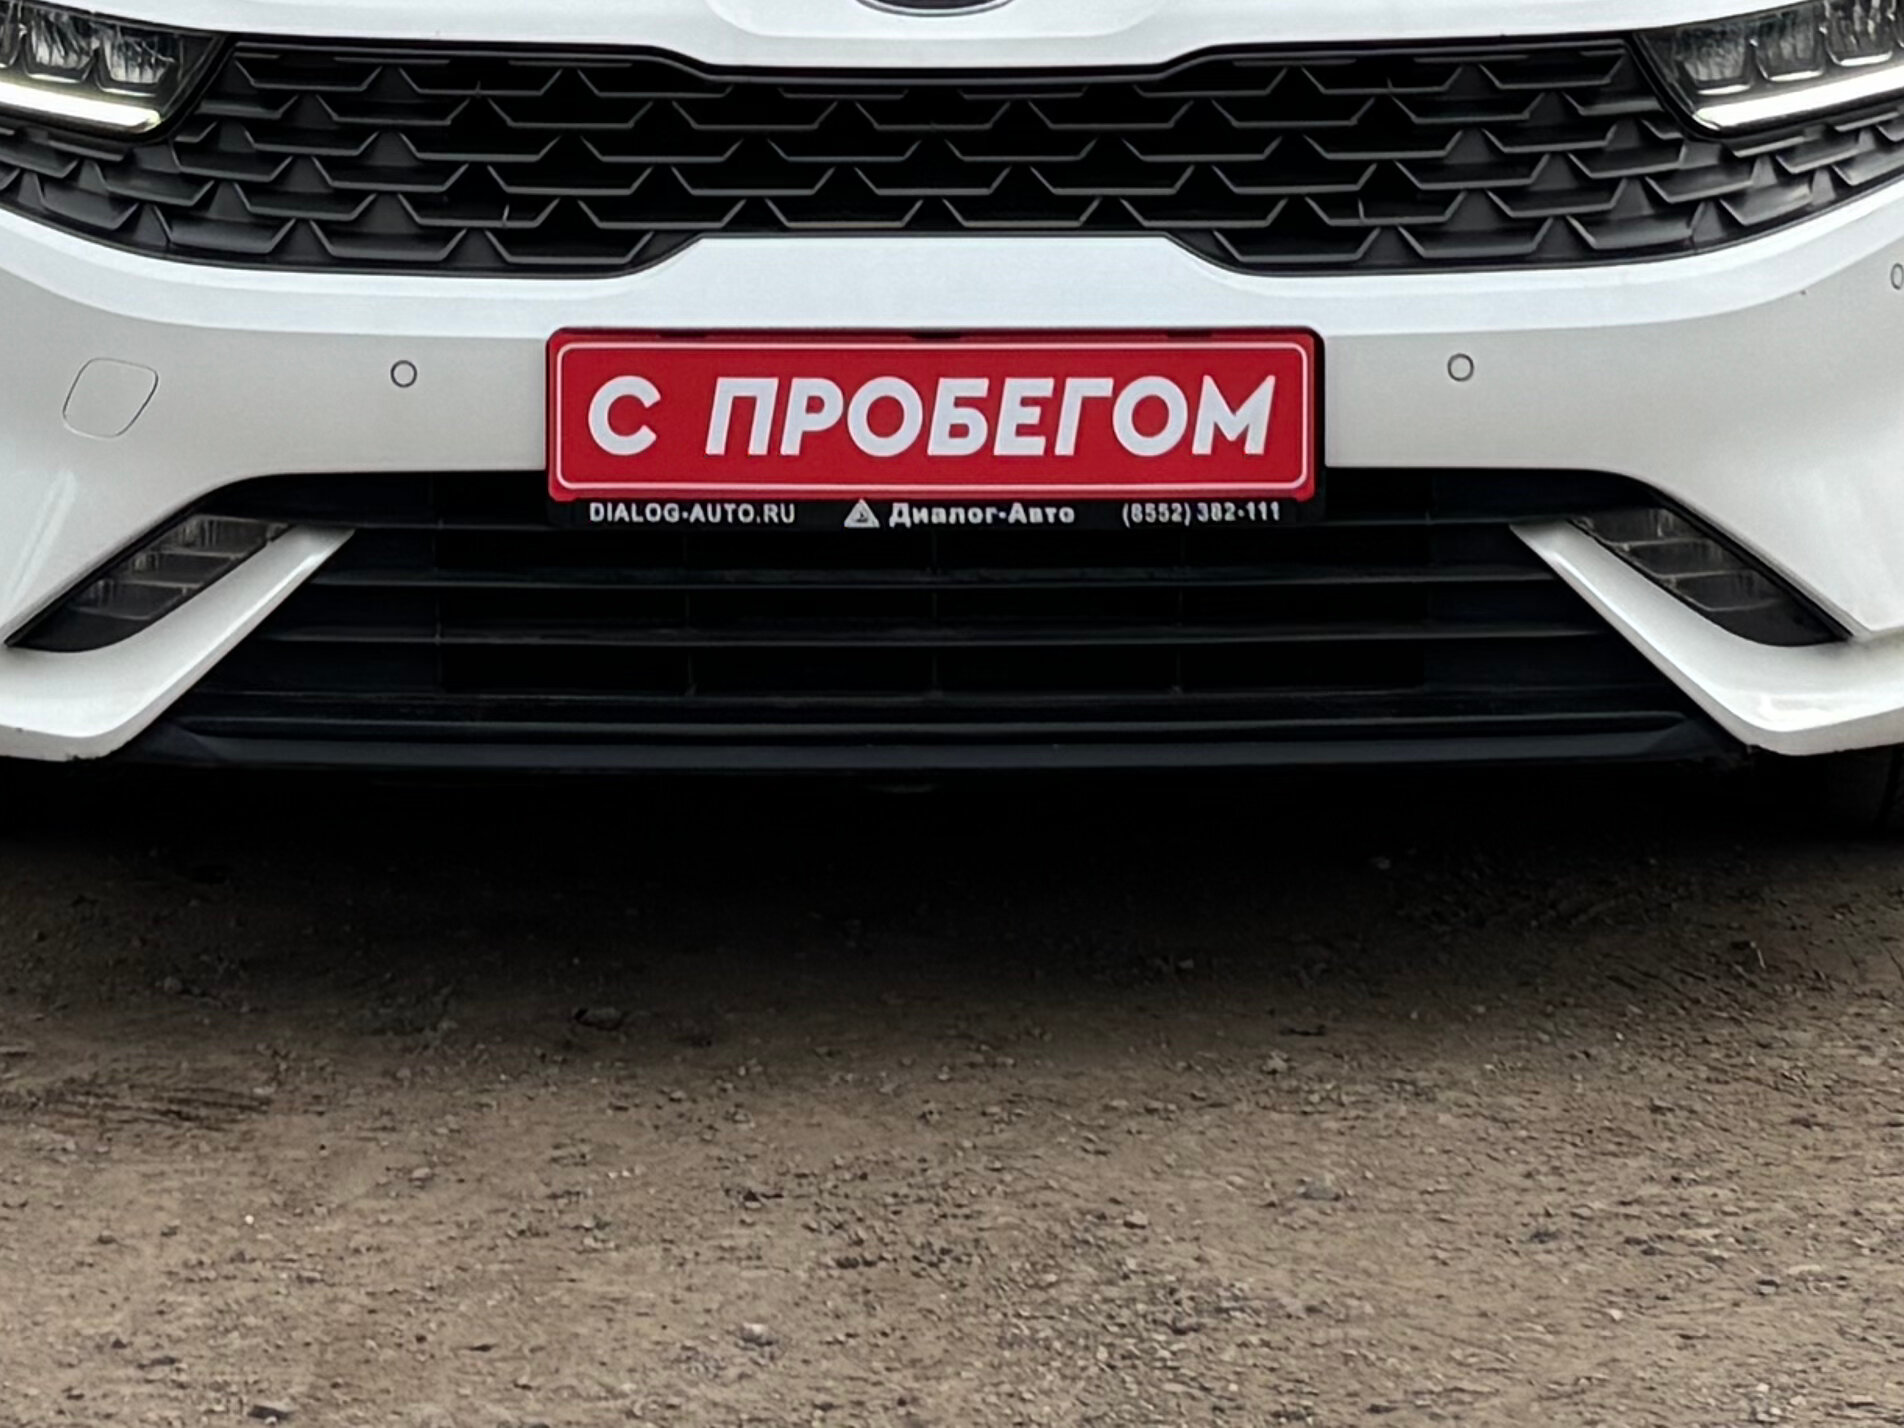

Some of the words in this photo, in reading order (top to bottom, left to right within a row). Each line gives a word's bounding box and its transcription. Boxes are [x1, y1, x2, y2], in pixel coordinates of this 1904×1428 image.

[587, 375, 662, 456] С
[705, 375, 1276, 456] ПРОБЕГОМ
[588, 502, 796, 524] DIALOG-AUTO.RU
